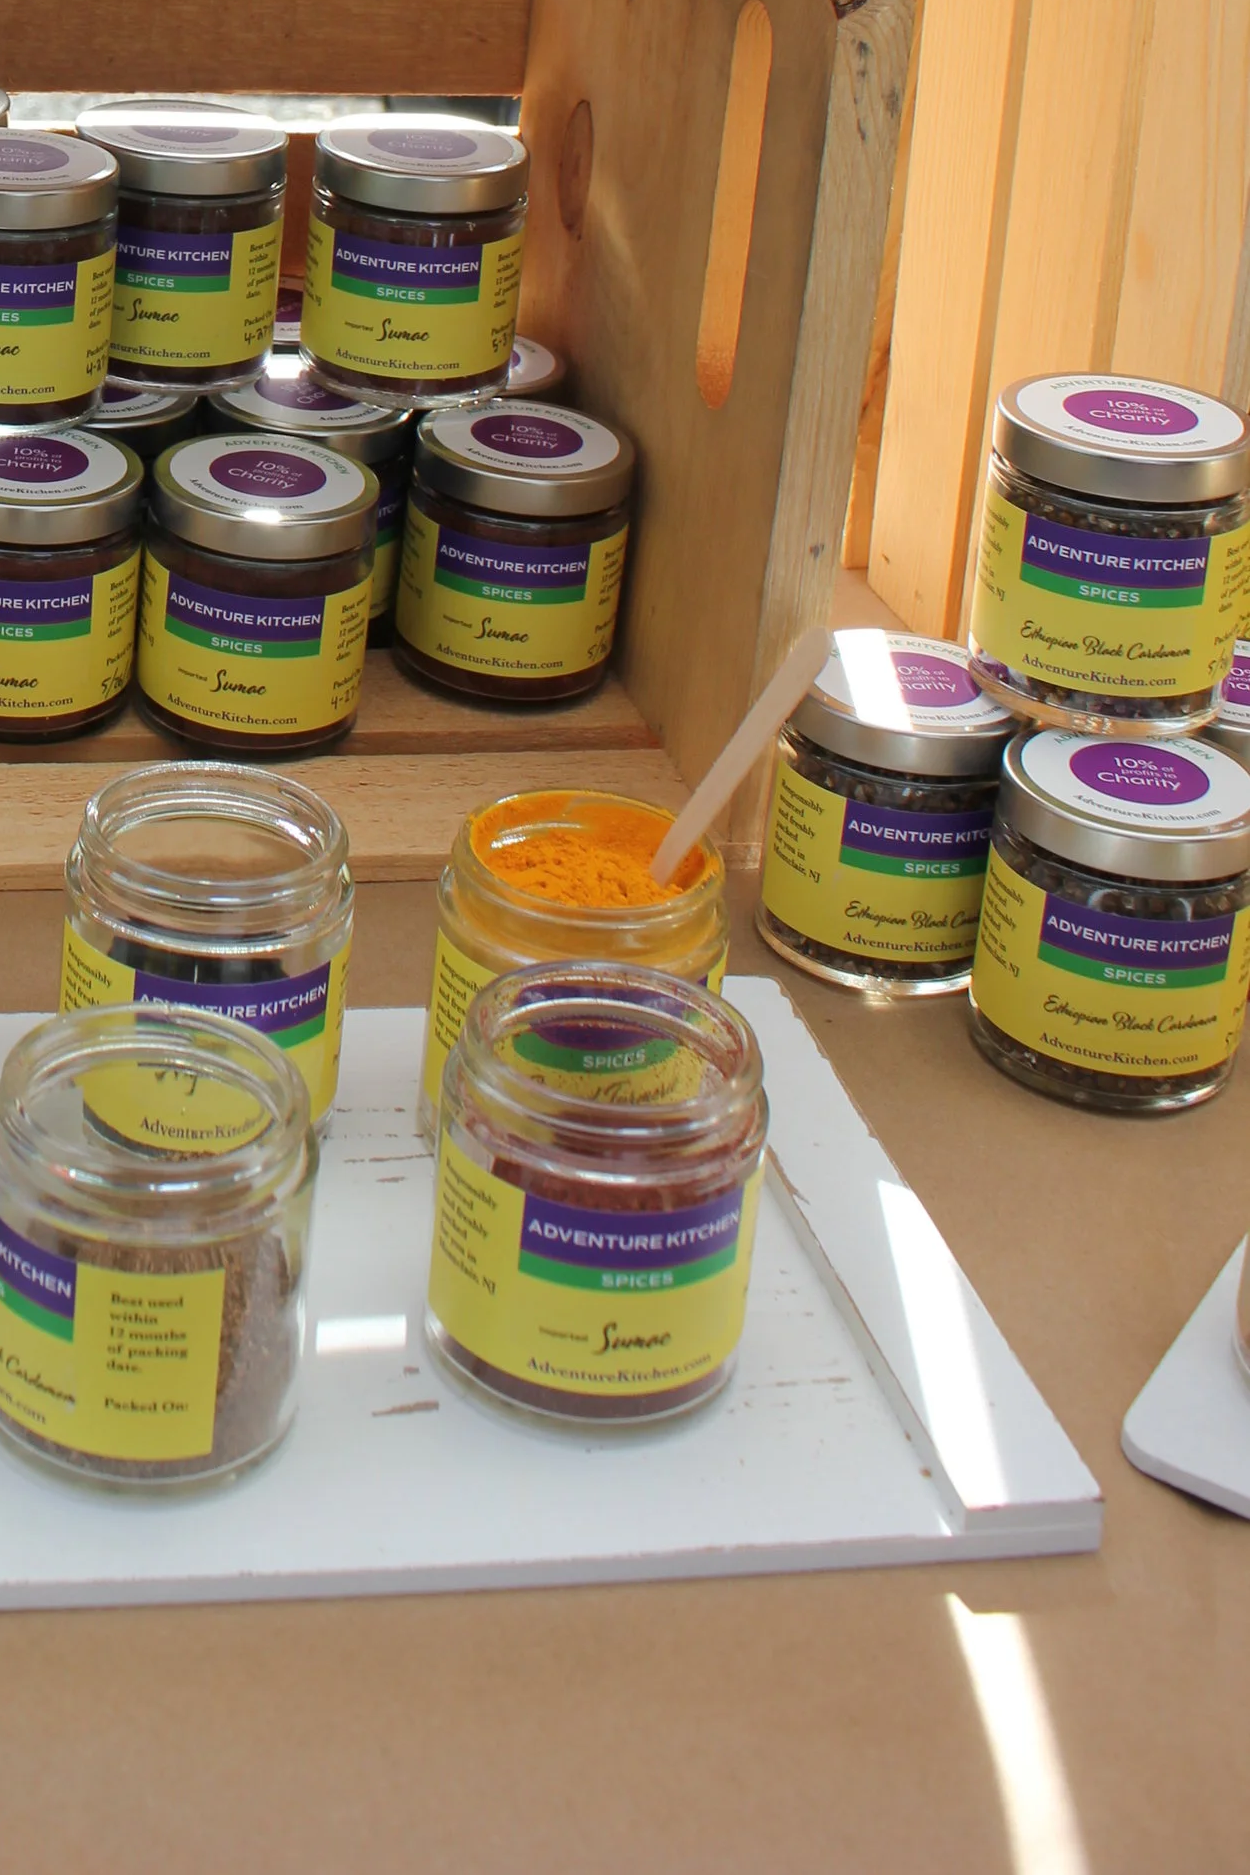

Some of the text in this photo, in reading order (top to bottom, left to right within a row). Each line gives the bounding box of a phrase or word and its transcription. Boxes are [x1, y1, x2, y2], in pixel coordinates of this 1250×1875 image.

[336, 248, 479, 274] ADVENTURE KITCHEN
[1079, 585, 1140, 603] SPICES
[1115, 757, 1158, 771] 10%
[1097, 771, 1181, 792] Charity
[1047, 915, 1230, 953] ADVENTURE KITCHEN
[1104, 967, 1167, 984] SPICES
[528, 1210, 739, 1251] ADVENTURE KITCHEN
[111, 1292, 184, 1308] Best used
